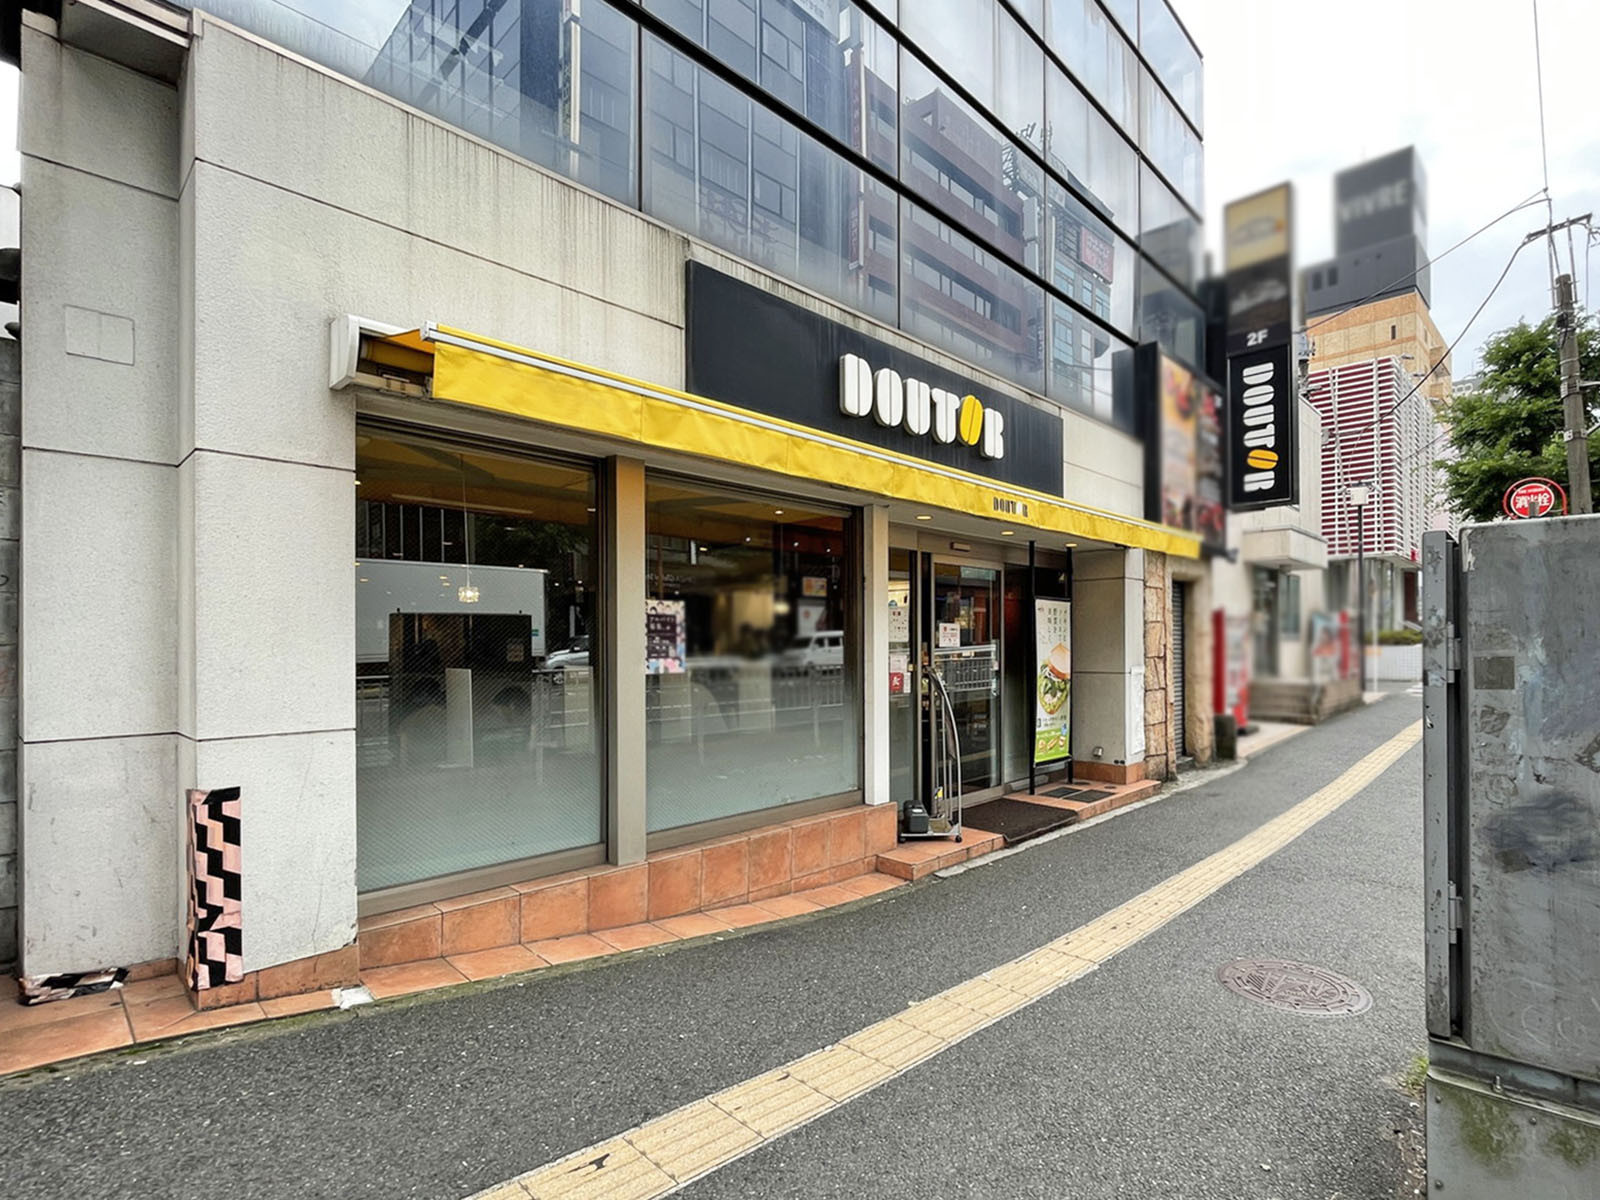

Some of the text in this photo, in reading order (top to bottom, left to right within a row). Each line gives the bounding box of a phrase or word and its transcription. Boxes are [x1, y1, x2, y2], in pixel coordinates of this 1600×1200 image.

[1246, 329, 1268, 346] 2F
[840, 353, 1004, 459] DOUTOR
[1243, 362, 1278, 492] DOUTOR
